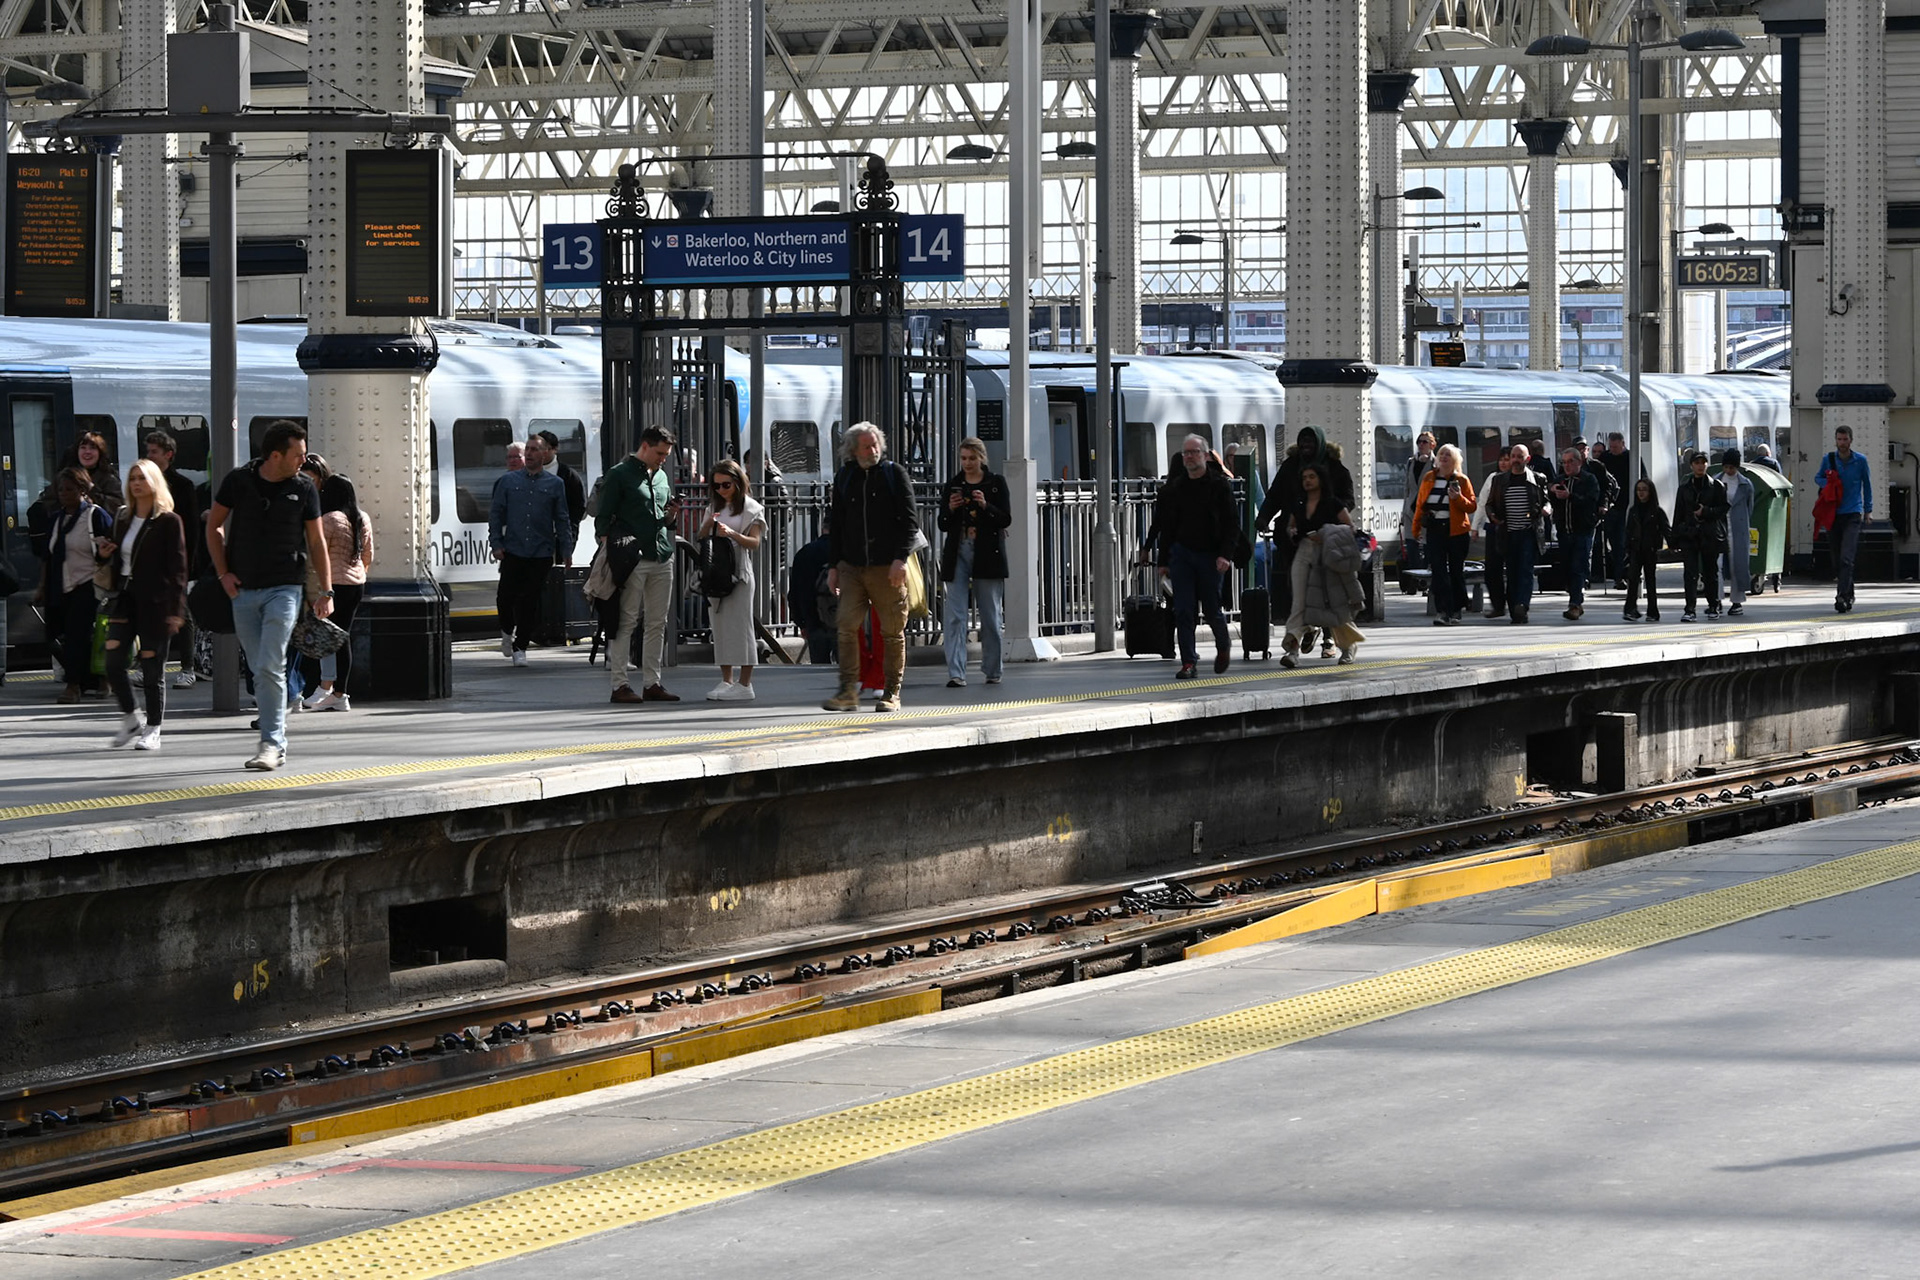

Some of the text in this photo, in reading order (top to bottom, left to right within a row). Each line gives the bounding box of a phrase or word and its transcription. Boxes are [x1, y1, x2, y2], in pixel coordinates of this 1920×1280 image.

[18, 167, 40, 177] 16:20
[59, 168, 75, 177] Plat
[17, 180, 64, 190] Weymouth &
[365, 223, 421, 231] Please check
[373, 231, 412, 239] timetable
[685, 228, 847, 249] Bakerloo, Northern and
[906, 227, 952, 262] 14
[551, 235, 595, 271] 13
[684, 250, 833, 268] Waterloo & City lines
[441, 530, 498, 567] Railwa
